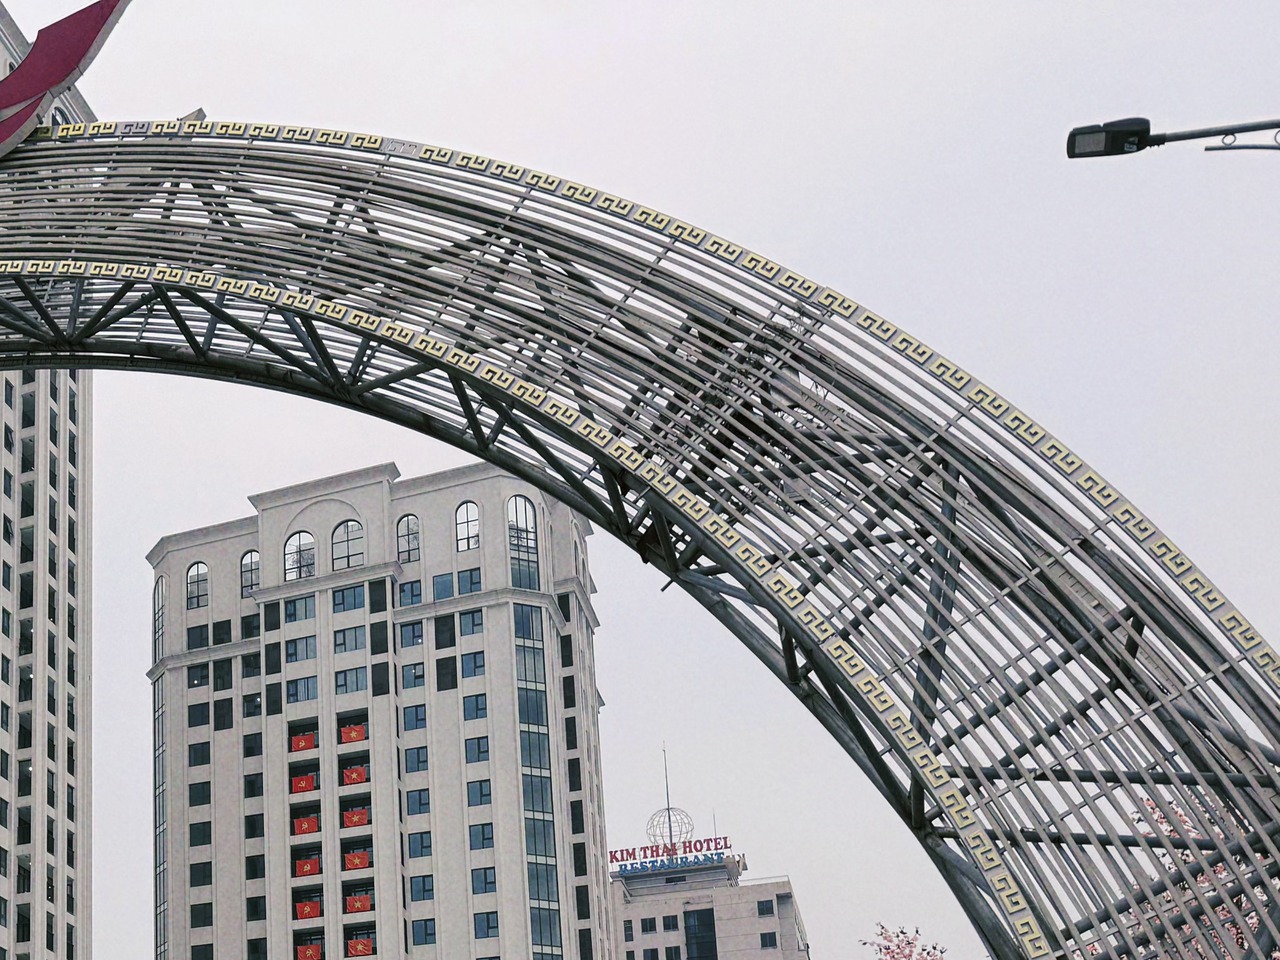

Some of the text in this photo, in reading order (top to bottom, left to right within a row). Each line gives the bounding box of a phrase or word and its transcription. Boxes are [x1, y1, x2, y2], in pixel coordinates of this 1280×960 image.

[609, 848, 637, 863] KIM
[682, 836, 732, 855] HOTEL
[618, 852, 725, 875] RESTAURANT
